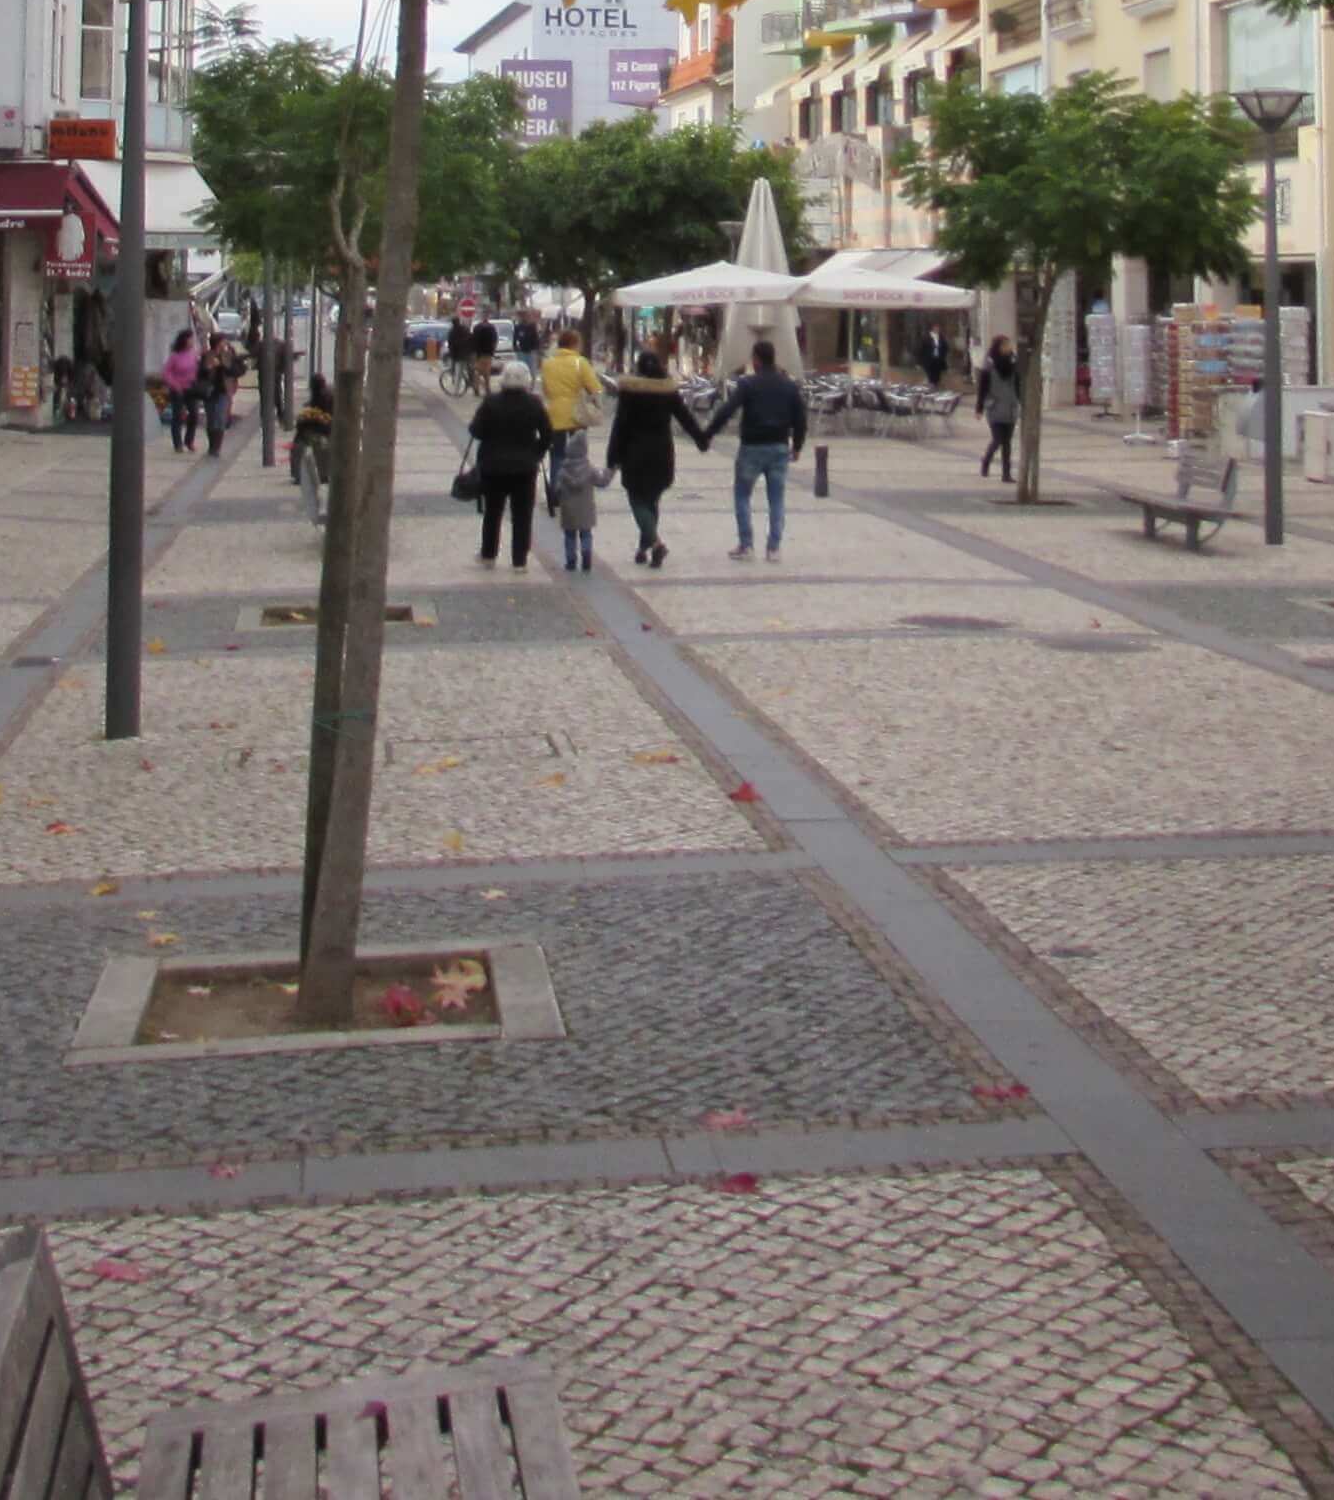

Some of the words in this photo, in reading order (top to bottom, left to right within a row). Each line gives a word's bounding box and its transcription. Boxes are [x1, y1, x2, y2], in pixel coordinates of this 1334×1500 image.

[544, 7, 638, 29] HOTEL
[506, 70, 568, 88] MUSEU
[611, 80, 627, 92] 112
[526, 94, 548, 112] de
